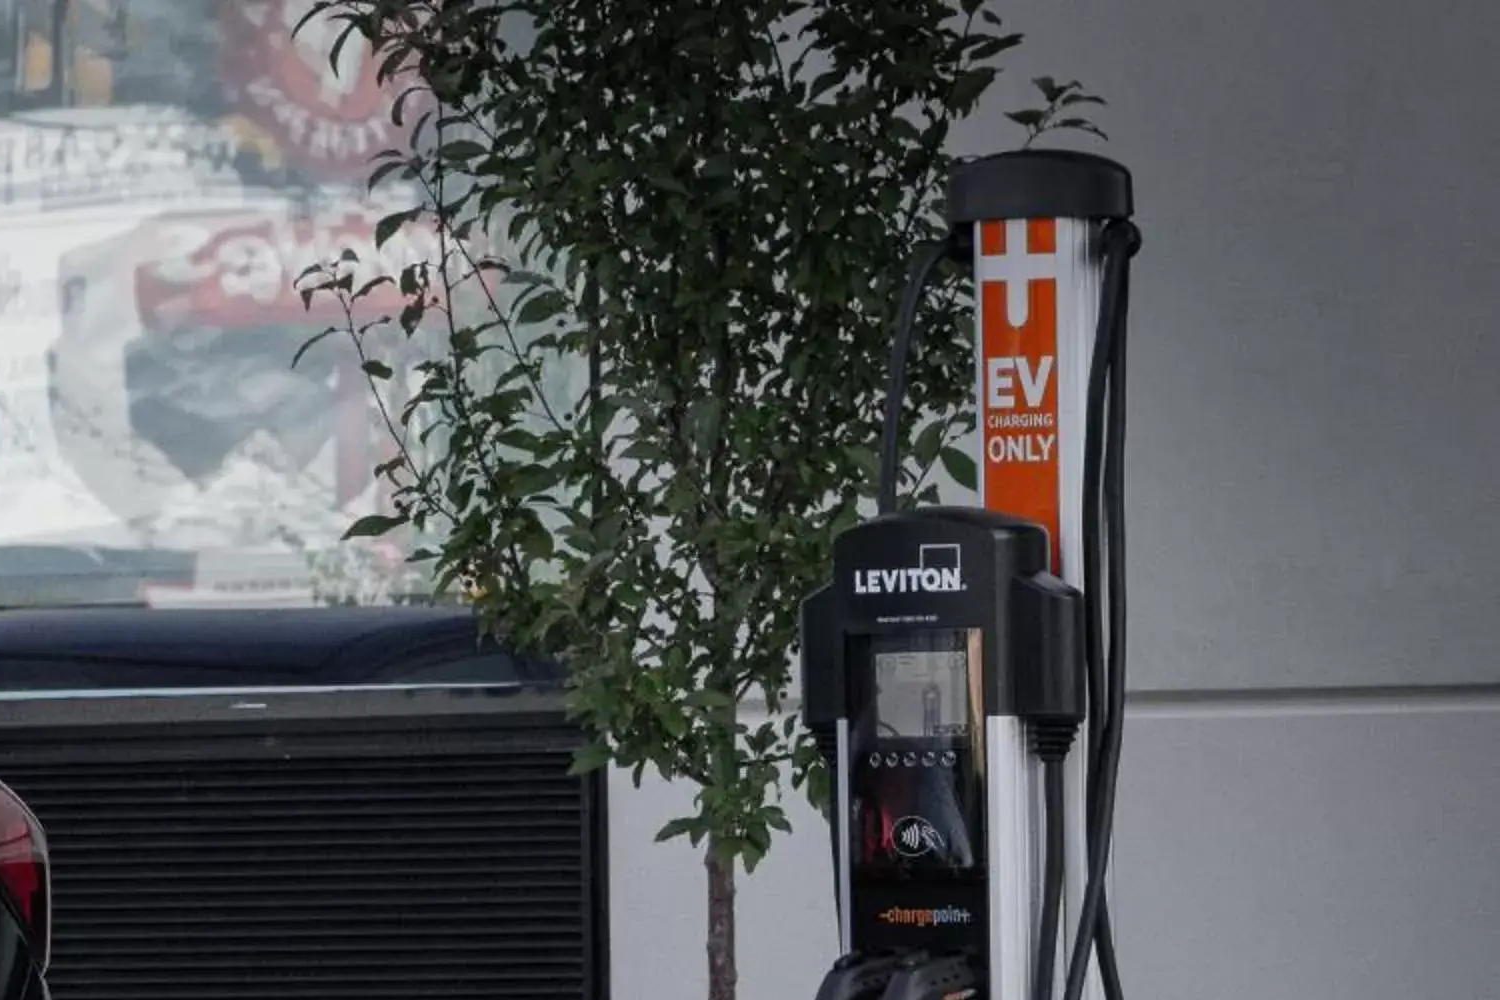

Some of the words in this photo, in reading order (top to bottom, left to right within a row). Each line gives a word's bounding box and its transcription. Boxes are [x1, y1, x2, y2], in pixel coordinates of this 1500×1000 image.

[987, 355, 1053, 409] EV
[989, 413, 1052, 428] CHARGING
[989, 434, 1055, 464] ONLY
